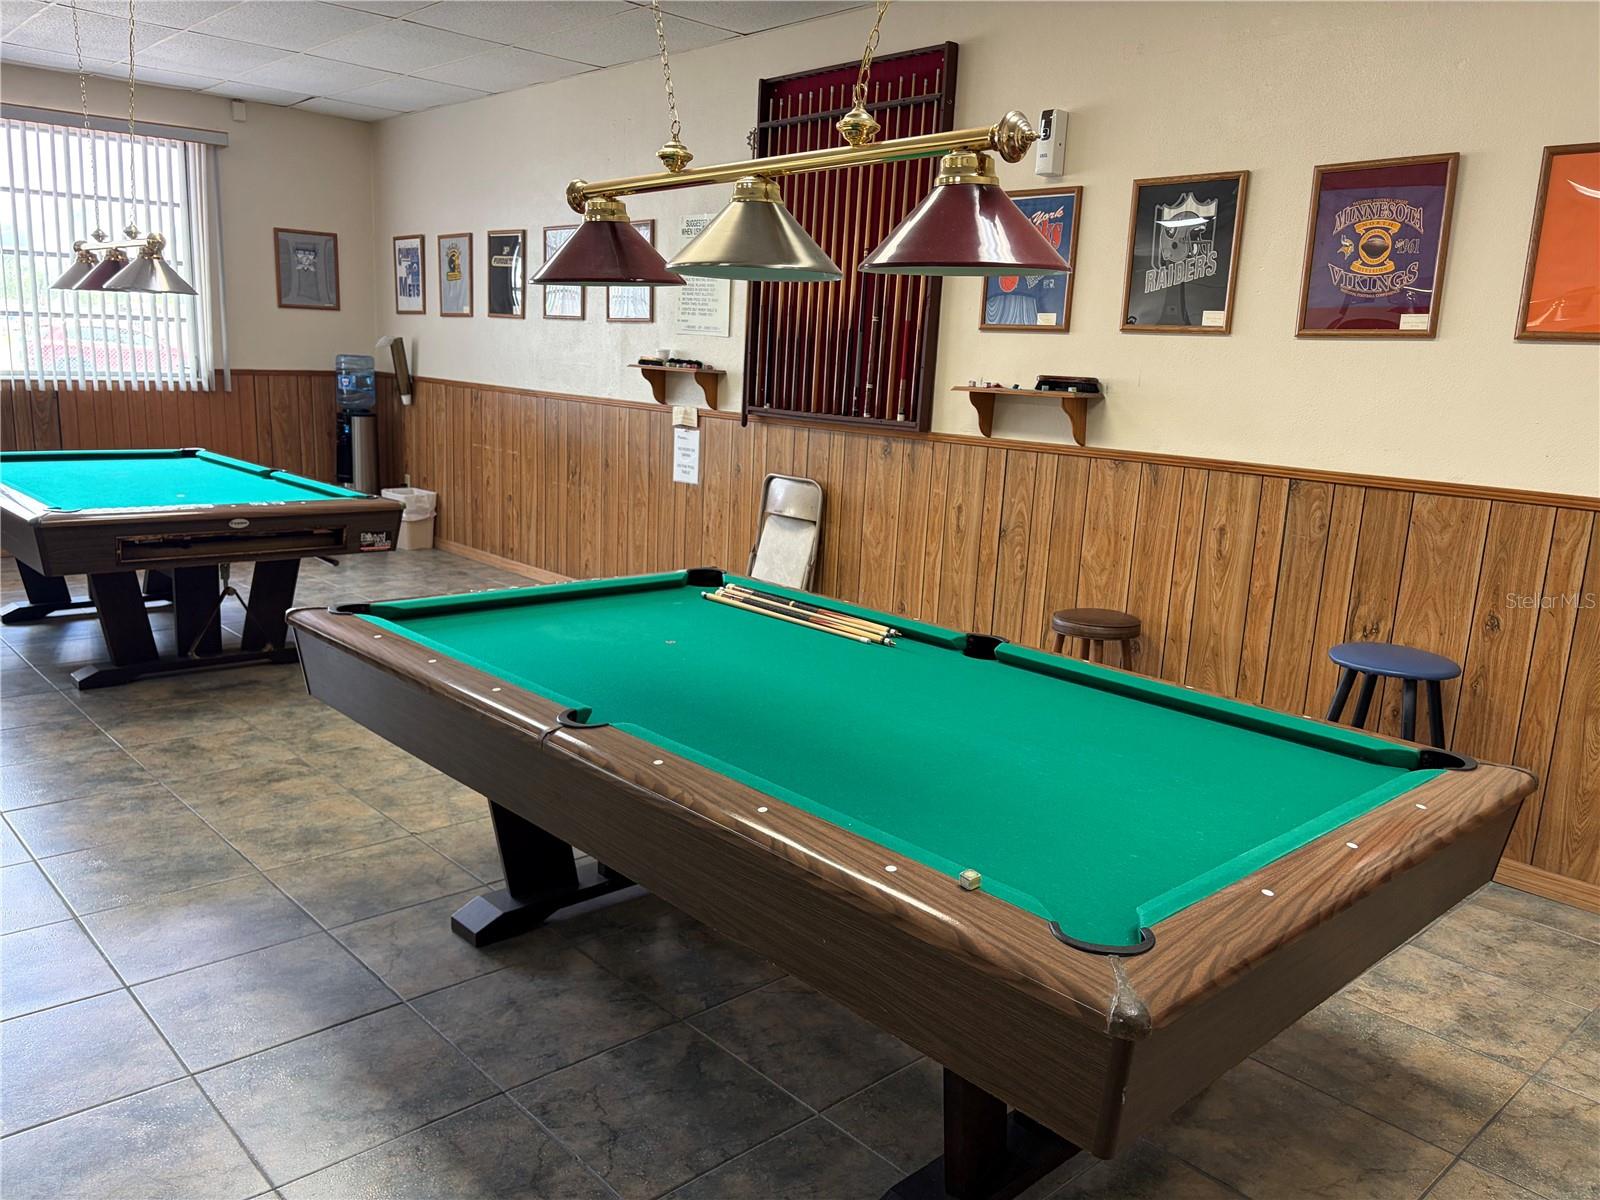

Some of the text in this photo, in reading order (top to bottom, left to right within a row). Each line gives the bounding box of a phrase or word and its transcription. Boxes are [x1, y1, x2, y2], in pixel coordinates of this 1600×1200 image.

[1332, 202, 1424, 236] MINNESOTA
[399, 276, 420, 297] METS
[1144, 250, 1218, 294] RAIDERS
[1327, 261, 1419, 293] VIKINGS
